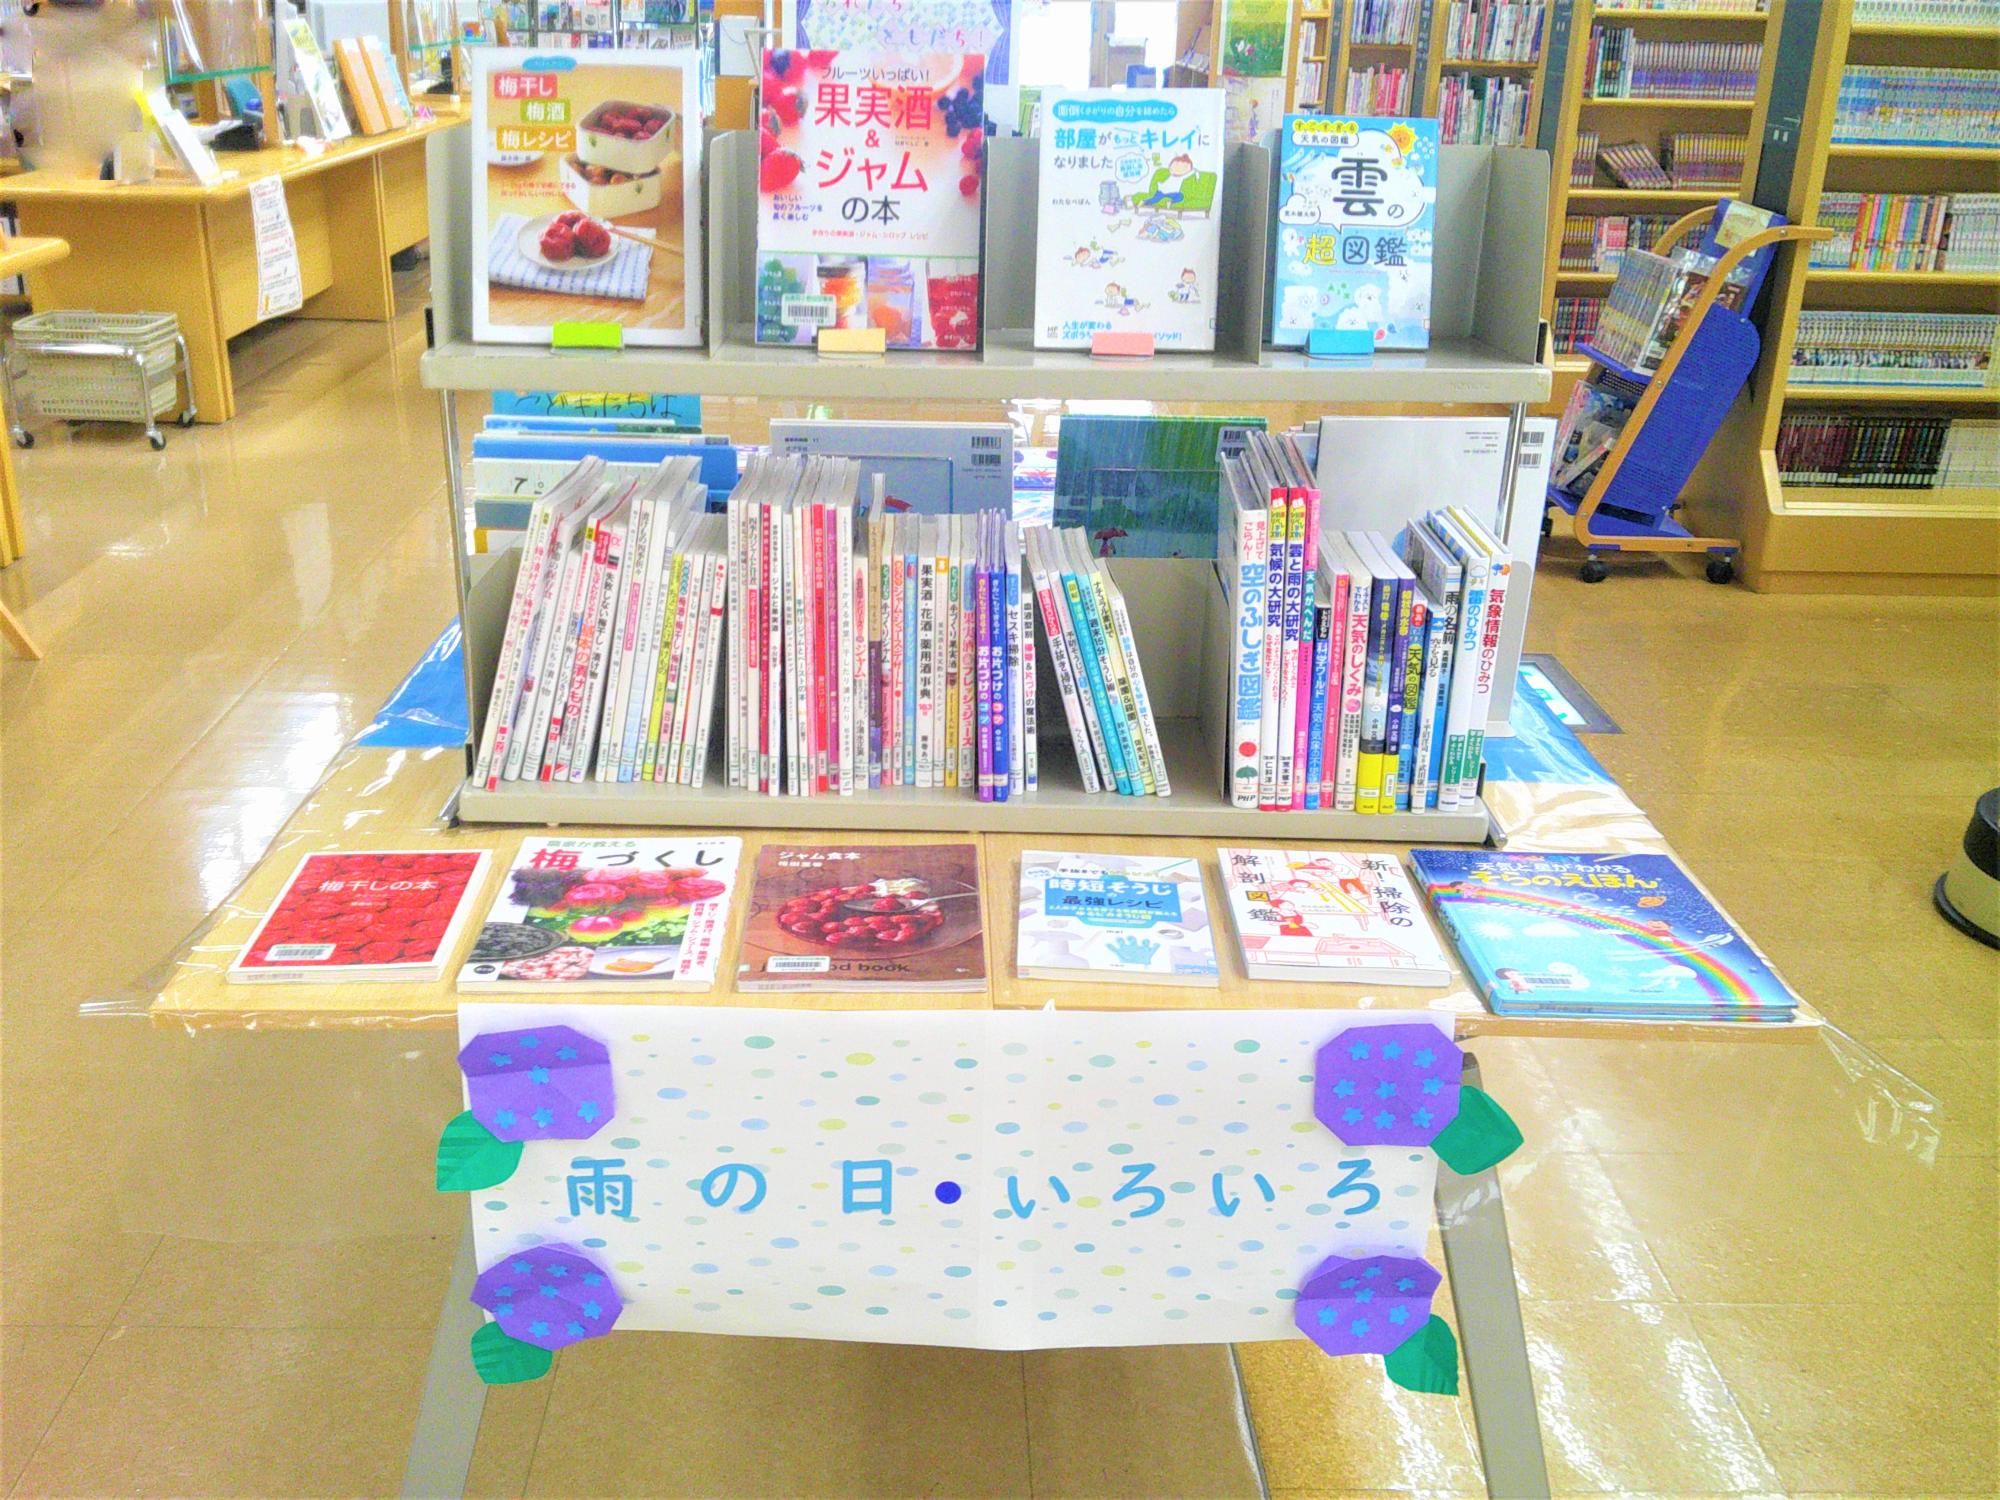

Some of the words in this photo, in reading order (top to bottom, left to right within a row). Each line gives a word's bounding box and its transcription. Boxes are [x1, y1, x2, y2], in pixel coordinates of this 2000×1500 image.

[499, 76, 553, 97] 梅干し
[822, 66, 930, 82] フルーツいっぱい!
[526, 101, 566, 122] 梅酒
[815, 83, 934, 131] 果実酒
[501, 130, 572, 149] 梅レシピ
[864, 129, 881, 148] &
[1293, 119, 1357, 133] すごすぎる
[1300, 133, 1350, 146] 天気の図鑑
[815, 147, 929, 192] ジャム
[1053, 155, 1114, 169] なりました
[841, 195, 901, 226] の本
[1303, 232, 1408, 267] 超図鑑
[1255, 521, 1266, 560] 見上げて
[1267, 543, 1284, 628] 気候の大研究
[1284, 543, 1303, 642] 雲と雨の大研究
[919, 564, 933, 699] 果実酒・花酒・薬用酒事典
[1443, 591, 1459, 645] 雨の名前
[1464, 589, 1484, 651] 雷のひみつ
[1236, 563, 1266, 721] 空のふしぎ図鑑
[1346, 614, 1369, 697] 天気のしくみ
[1478, 589, 1506, 695] 気象情報のひみつ
[1315, 642, 1328, 699] 科学ワールド
[1404, 648, 1423, 710] 天気の図鑑
[529, 848, 725, 871] 梅づくし
[778, 850, 861, 860] ジャム食本
[1475, 862, 1631, 874] 天気と星がわかる
[318, 879, 440, 893] 梅干しの本
[1049, 878, 1173, 896] 時短そうじ
[1231, 854, 1281, 922] 解剖図鑑
[1361, 859, 1413, 928] 新!掃除の
[1468, 870, 1659, 889] そらのえほん
[1062, 895, 1165, 909] 最強レシピ
